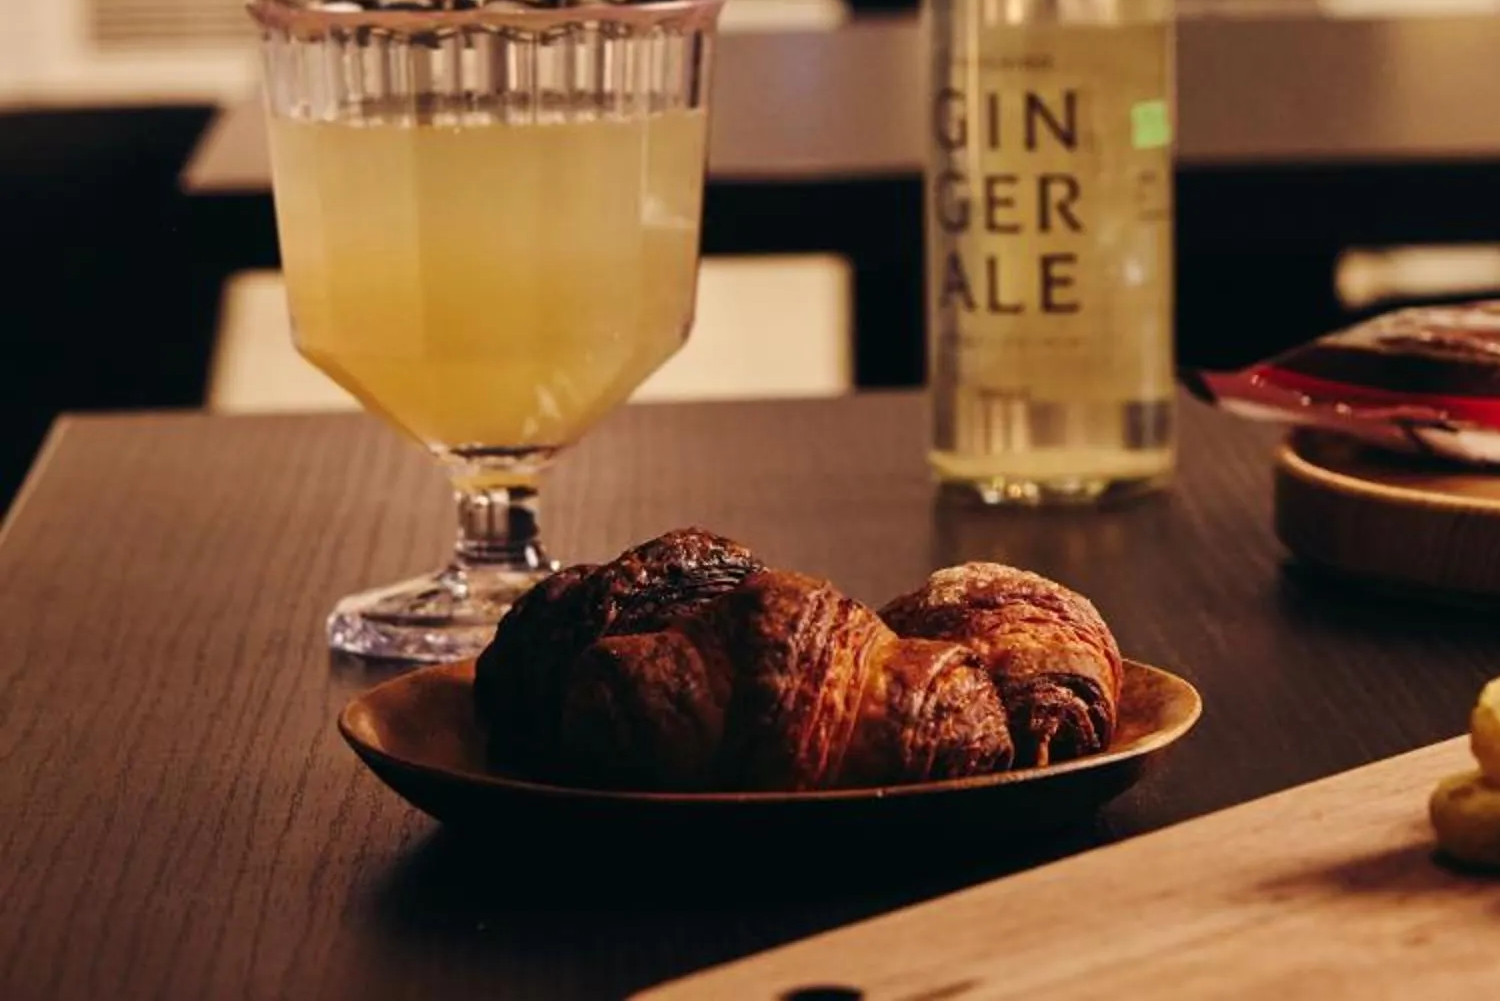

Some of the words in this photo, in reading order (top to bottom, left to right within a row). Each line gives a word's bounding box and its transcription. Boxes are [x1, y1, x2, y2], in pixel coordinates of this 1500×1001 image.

[934, 88, 1077, 151] GIN
[935, 170, 1082, 233] GER
[940, 252, 1082, 314] ALE
